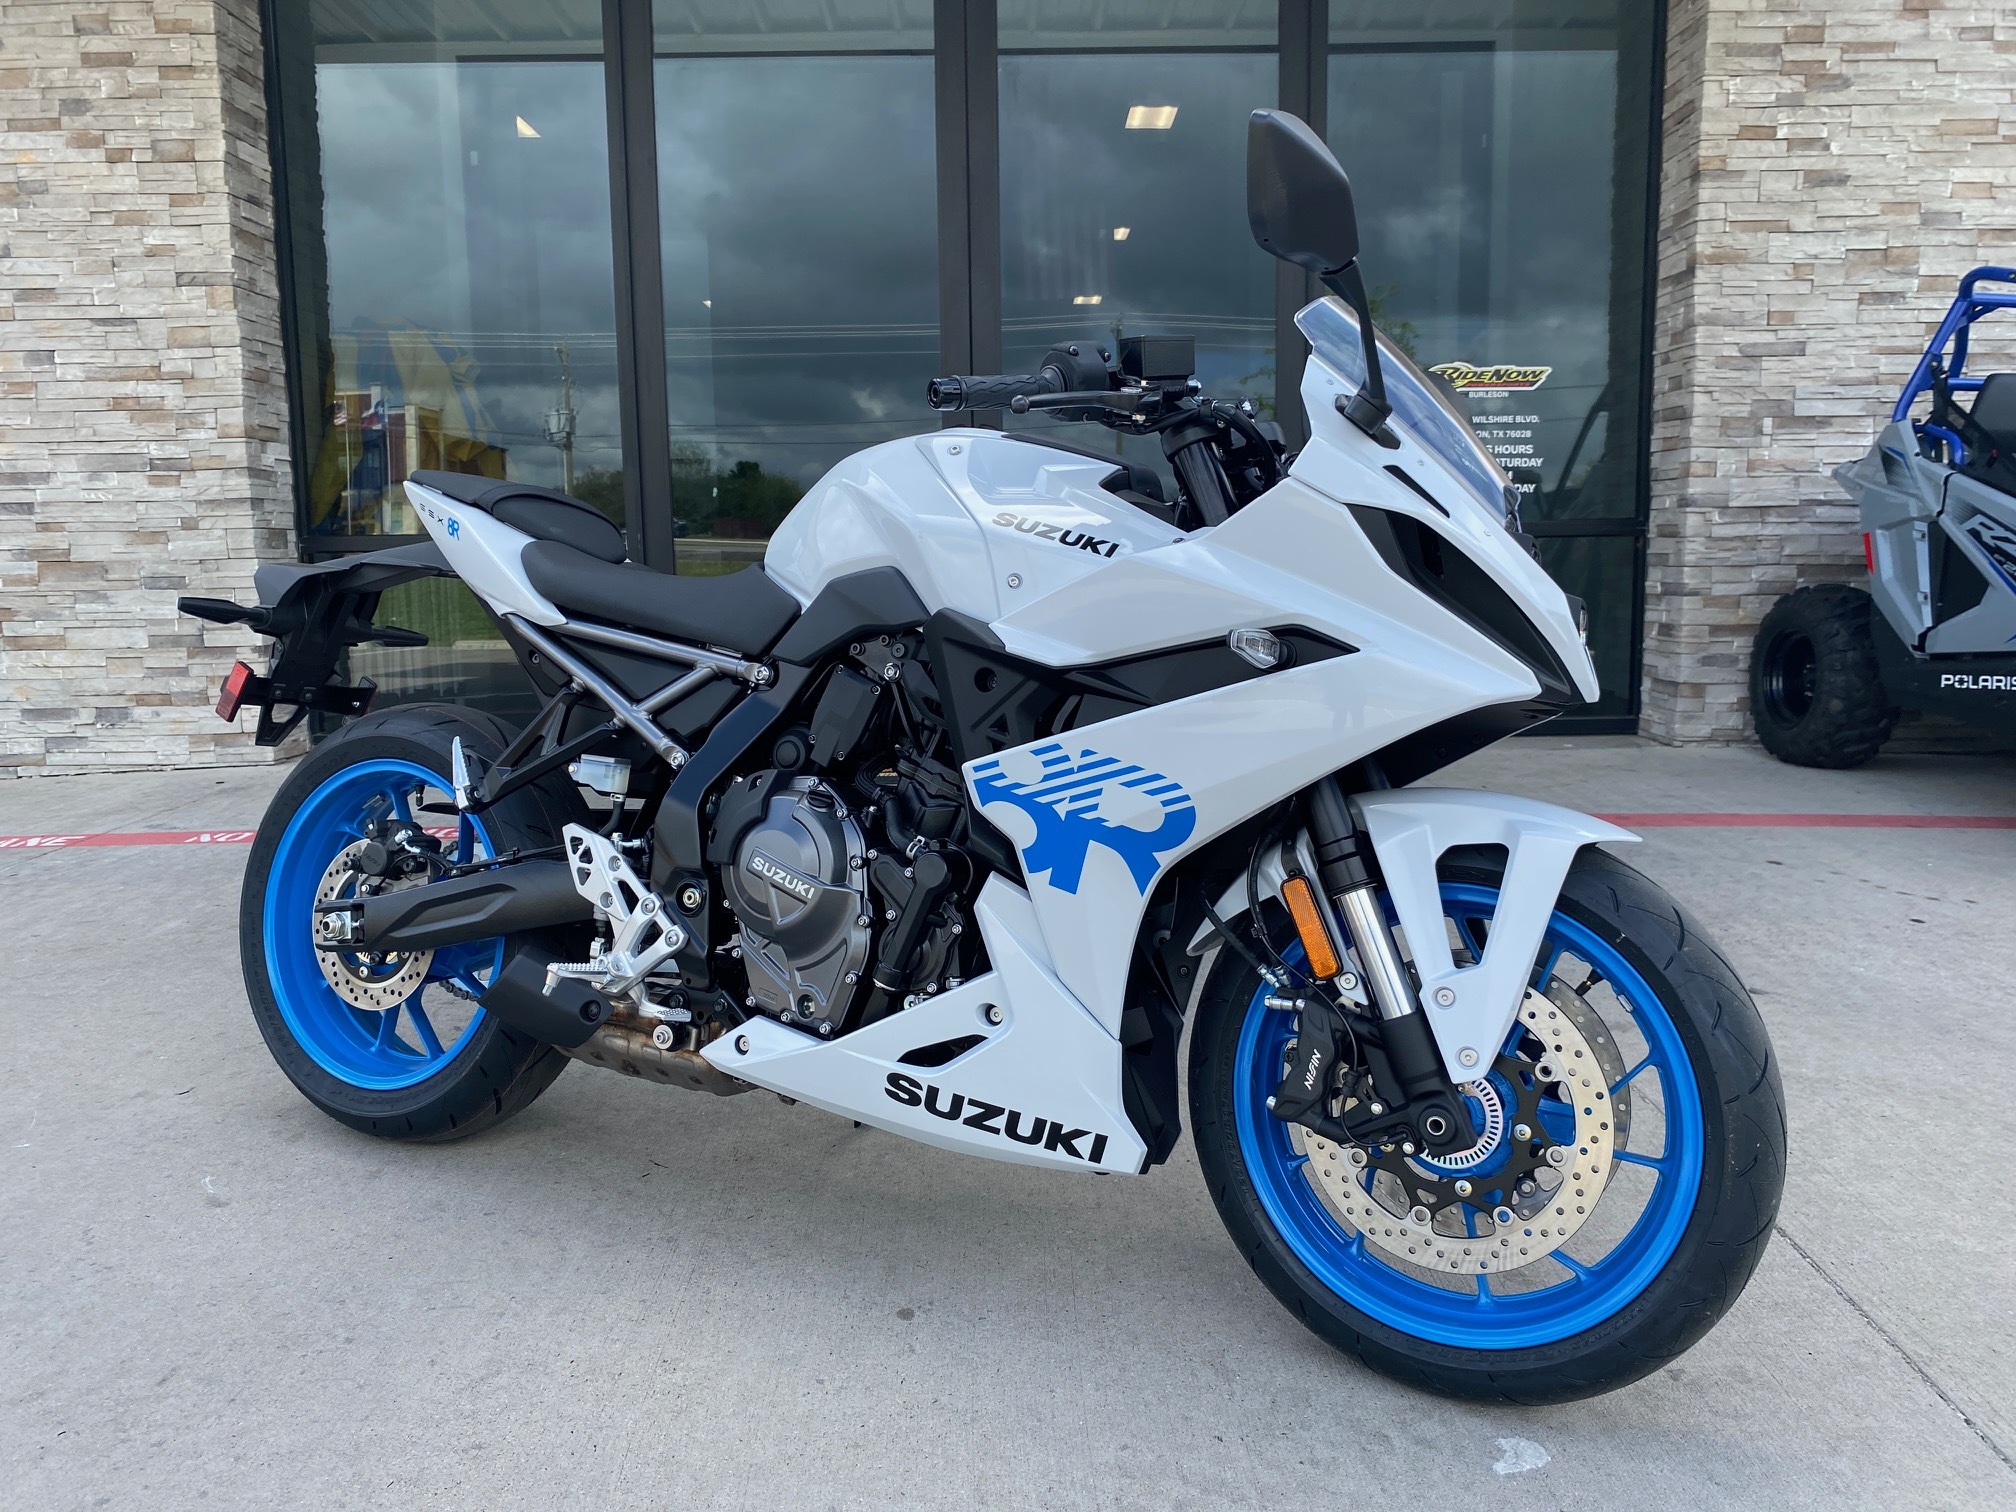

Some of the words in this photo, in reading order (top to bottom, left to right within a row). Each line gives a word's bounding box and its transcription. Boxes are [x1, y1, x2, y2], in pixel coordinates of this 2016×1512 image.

[1472, 415, 1514, 424] WILSHIRE
[1515, 415, 1540, 424] BLVD.
[1492, 430, 1504, 438] TX
[1505, 430, 1532, 438] 76028
[1494, 444, 1534, 454] HOURS
[992, 512, 1120, 558] SUZUKI
[751, 856, 815, 899] SUZUKI
[1303, 1048, 1322, 1091] NISSIN
[884, 1072, 1109, 1164] SUZUKI
